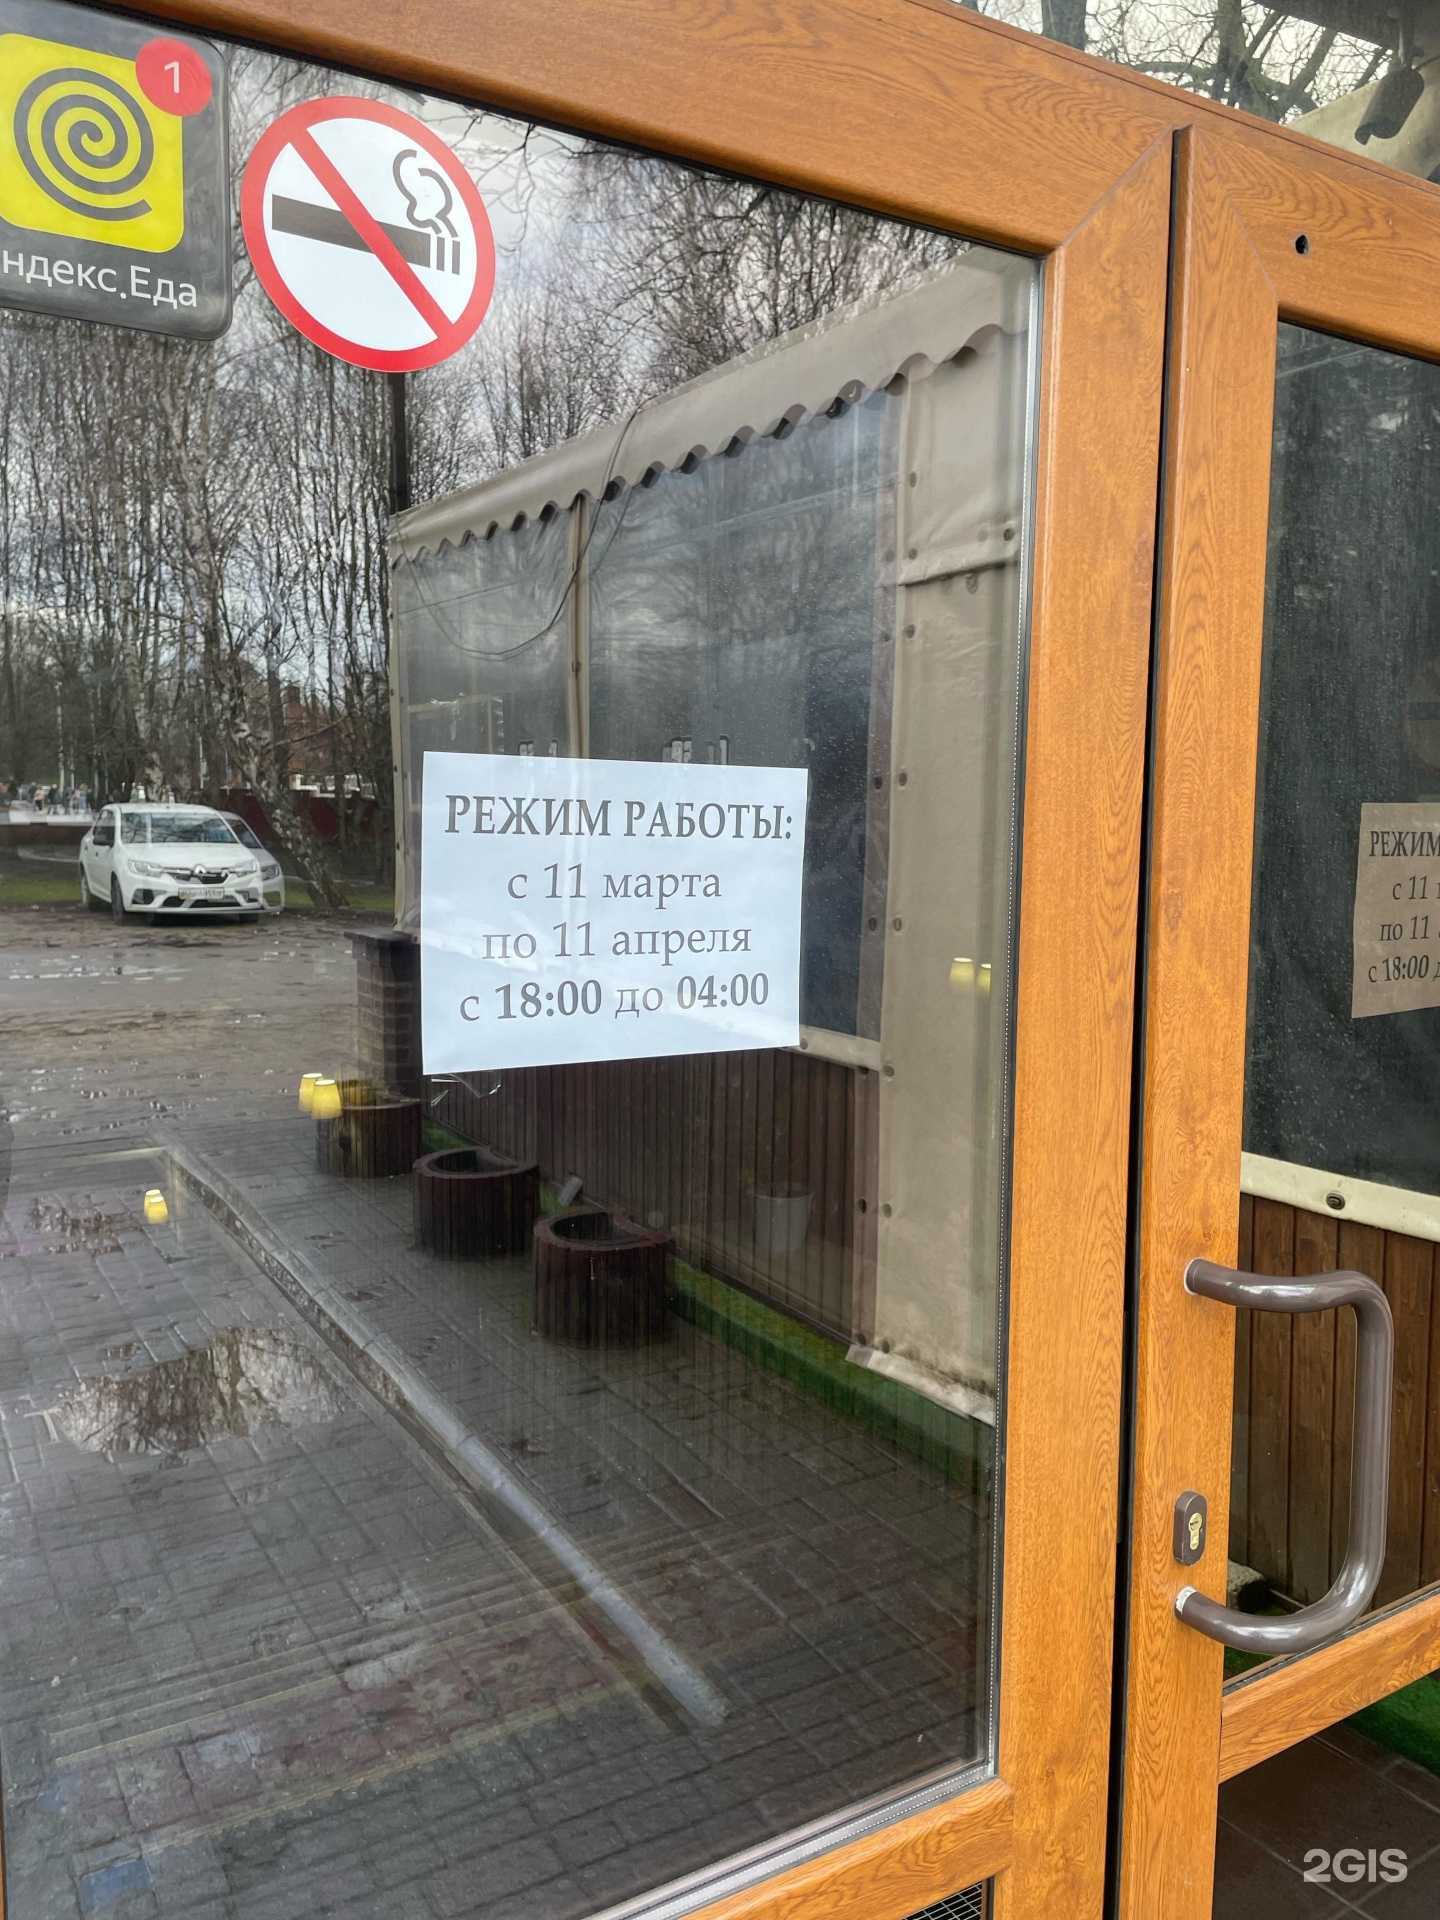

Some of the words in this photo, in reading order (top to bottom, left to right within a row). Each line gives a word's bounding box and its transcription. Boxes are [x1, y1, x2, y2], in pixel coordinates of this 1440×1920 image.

[163, 61, 181, 94] 1
[445, 794, 612, 837] РЕЖИМ
[623, 800, 793, 841] РАБОТЫ:
[507, 872, 528, 899] с
[543, 862, 587, 899] 11
[602, 871, 722, 910] марта
[1392, 882, 1402, 900] с
[1408, 875, 1428, 900] 11
[481, 931, 537, 960] по
[552, 921, 596, 957] 11
[611, 927, 752, 966] апреля
[1379, 923, 1403, 941] по
[1409, 915, 1430, 940] 11
[1368, 966, 1377, 983] с
[1382, 954, 1429, 982] 18:00
[459, 994, 480, 1021] с
[495, 979, 601, 1020] 18:00
[614, 986, 664, 1018] до
[676, 972, 769, 1009] 04:00
